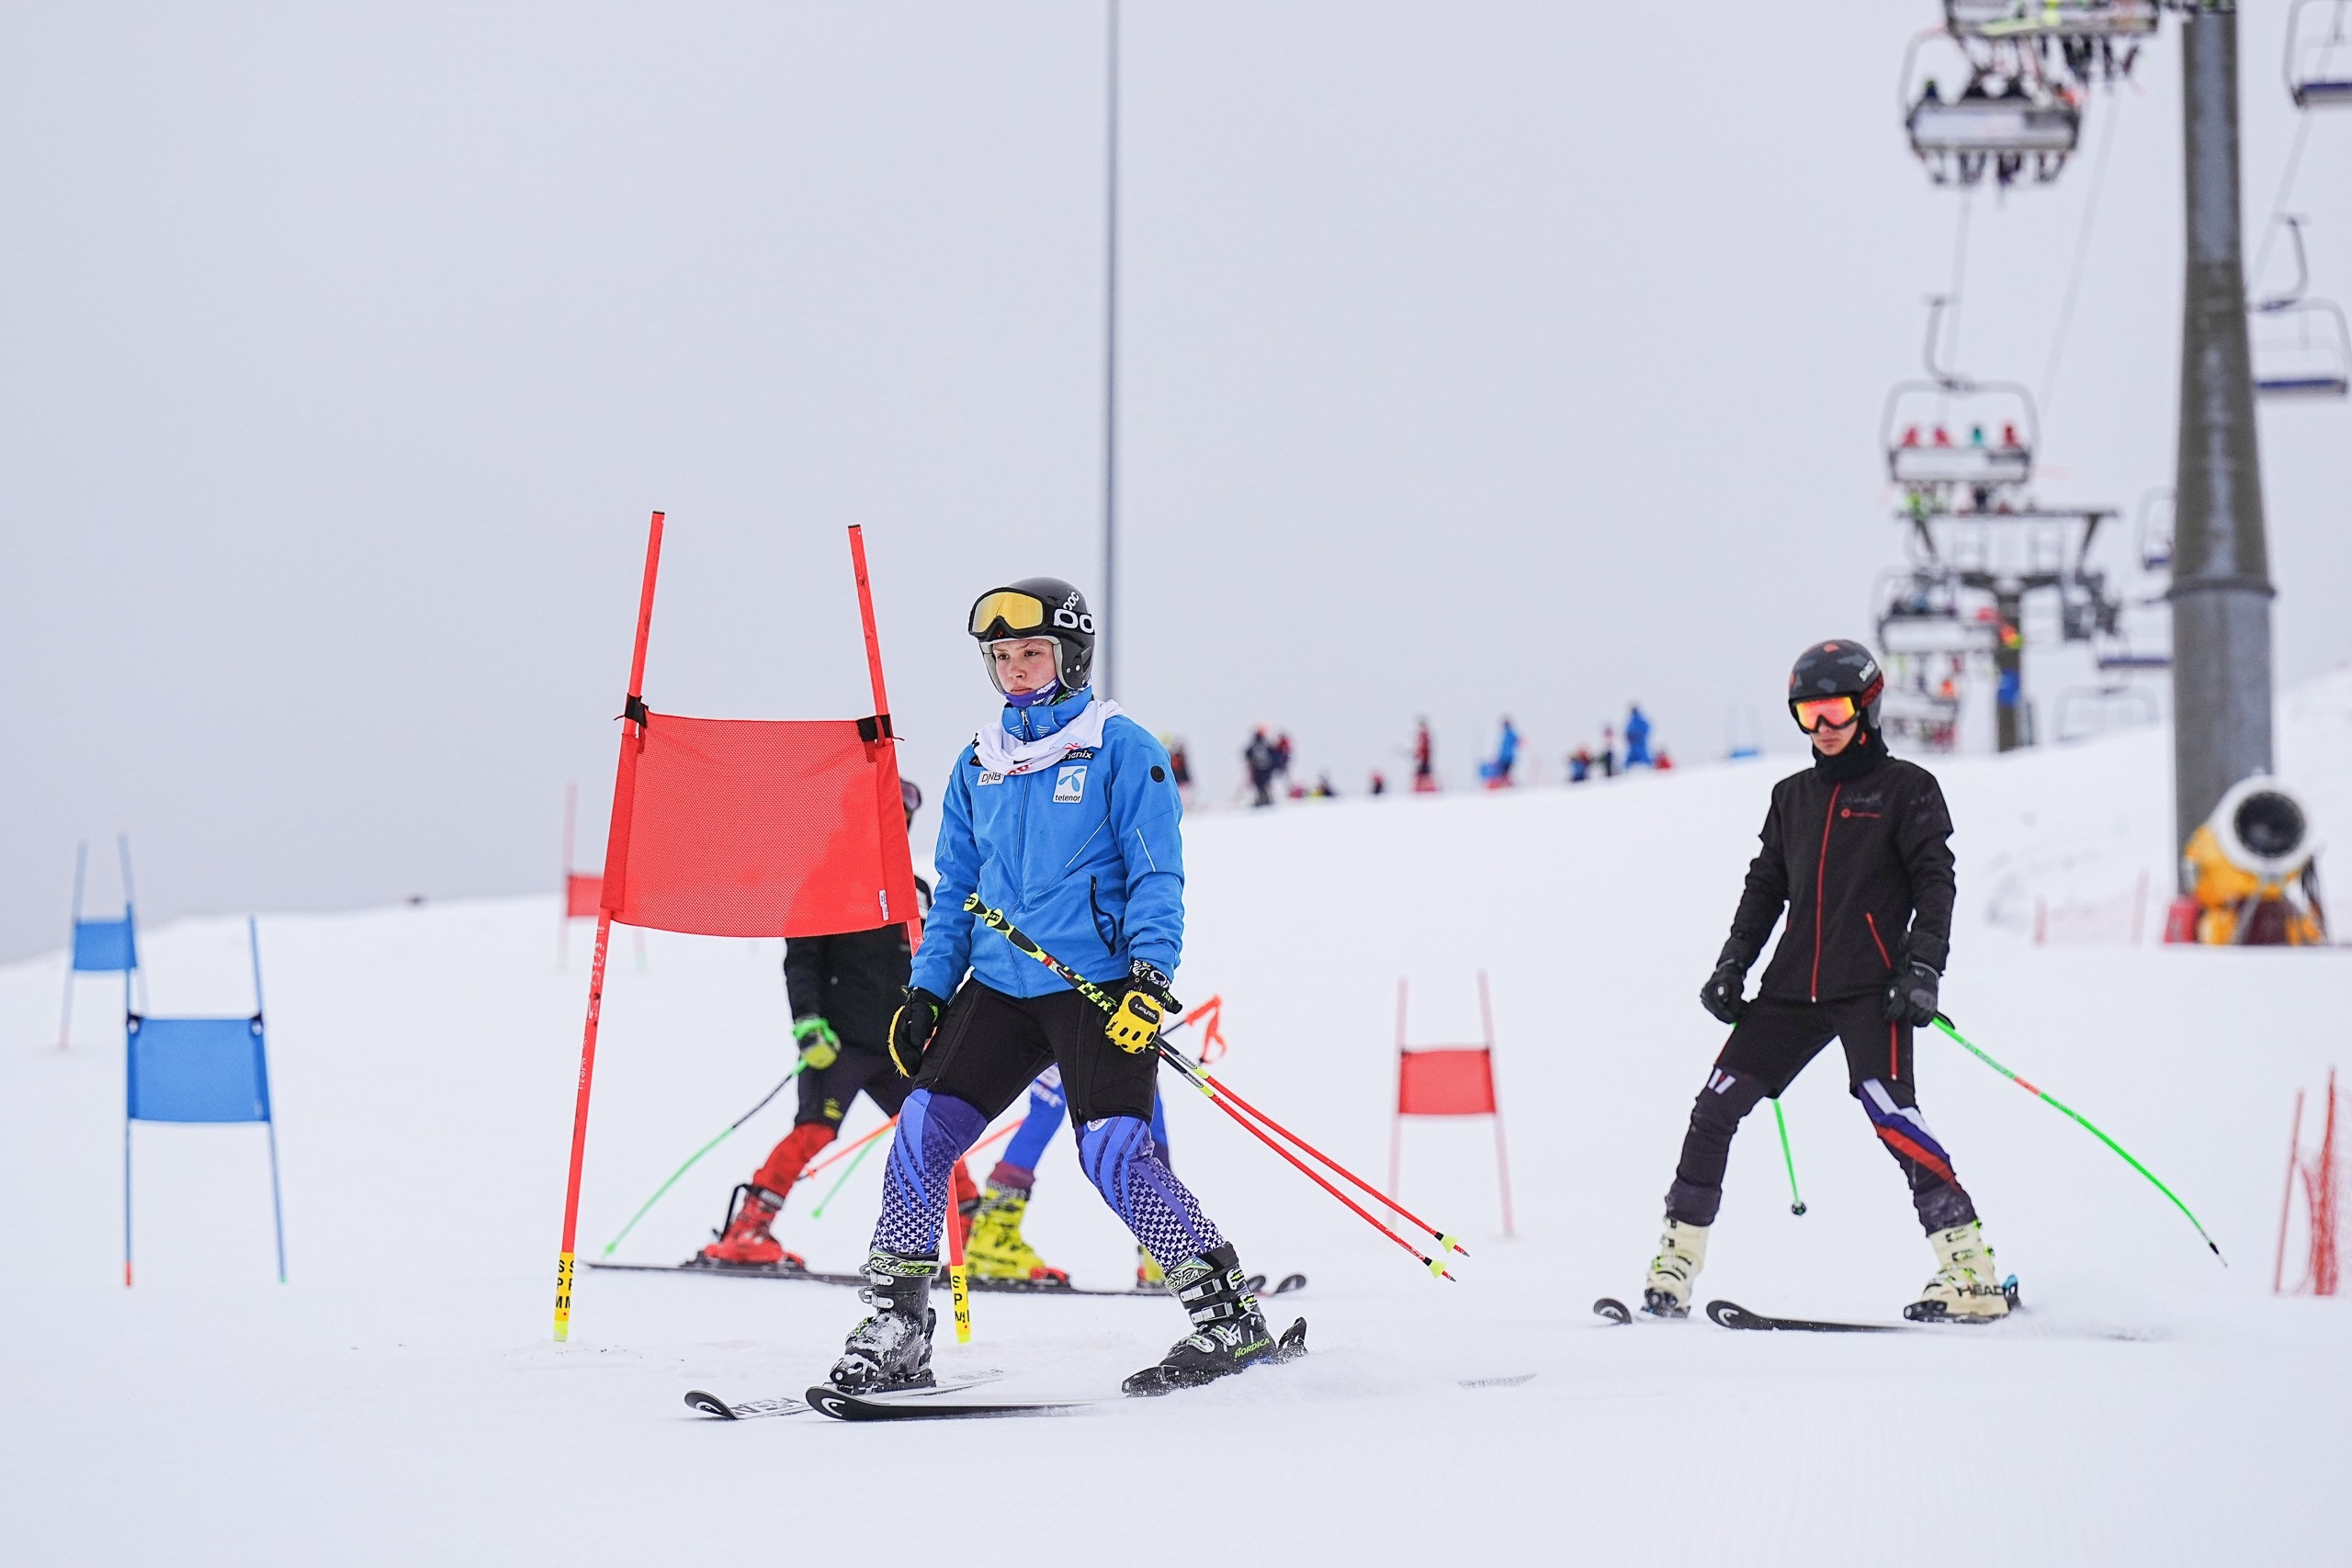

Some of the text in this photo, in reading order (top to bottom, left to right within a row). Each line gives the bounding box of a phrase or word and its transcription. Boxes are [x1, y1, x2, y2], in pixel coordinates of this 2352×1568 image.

[1053, 608, 1093, 634] PO
[981, 772, 1001, 784] DNB
[1077, 983, 1114, 1016] LEK
[1135, 1003, 1158, 1021] LEVEL
[872, 1259, 931, 1274] NORDICA
[1234, 1337, 1271, 1359] NORDICA
